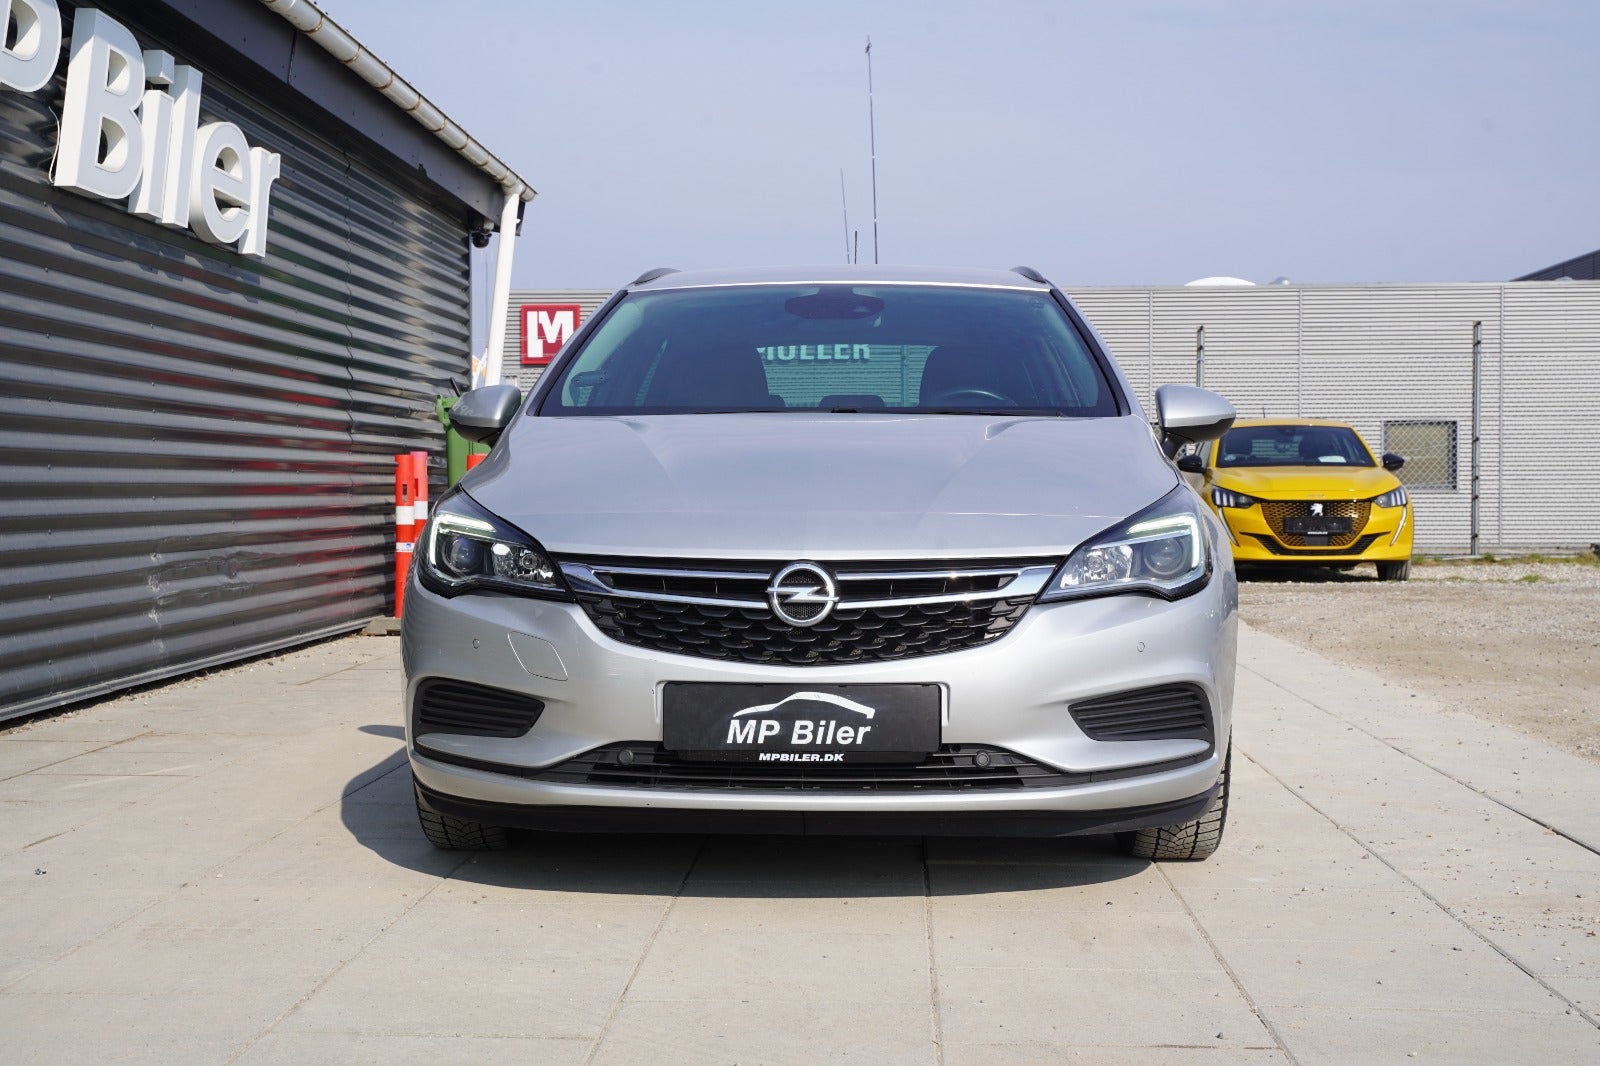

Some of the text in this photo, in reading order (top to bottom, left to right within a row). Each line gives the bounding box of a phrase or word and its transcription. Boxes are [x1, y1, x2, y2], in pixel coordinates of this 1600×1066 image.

[53, 7, 281, 258] Biler
[727, 719, 871, 745] MP Biler
[758, 753, 844, 762] MPBILER.DK
